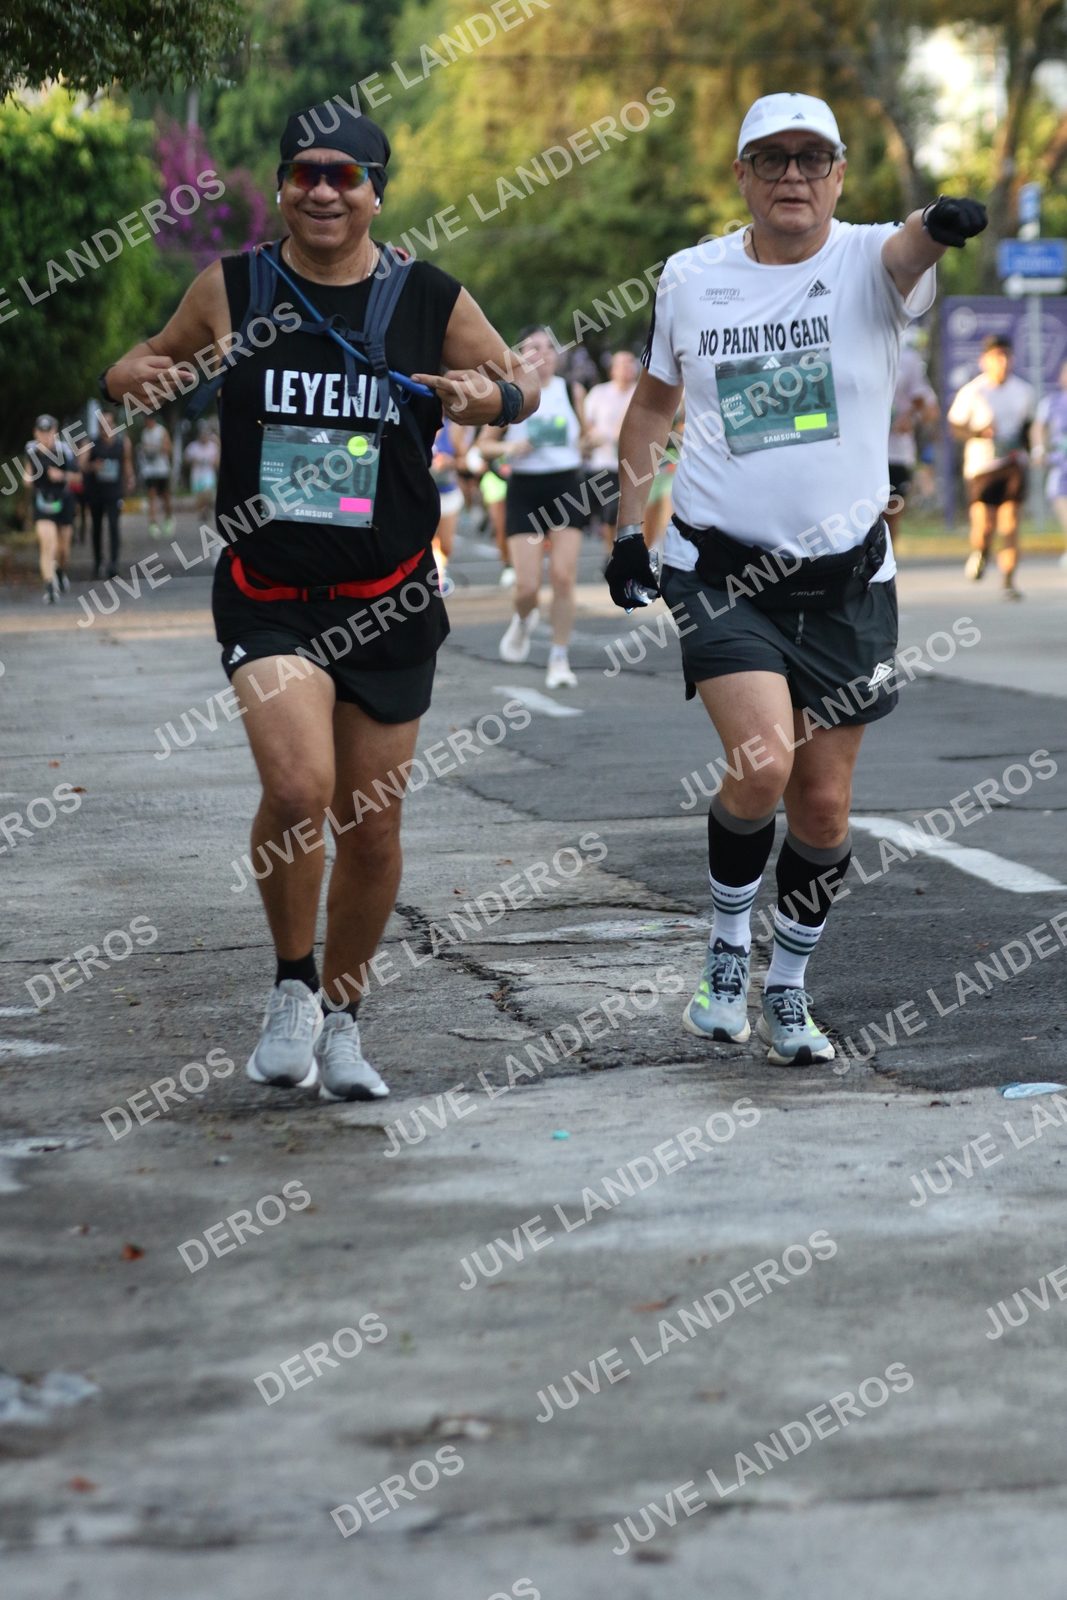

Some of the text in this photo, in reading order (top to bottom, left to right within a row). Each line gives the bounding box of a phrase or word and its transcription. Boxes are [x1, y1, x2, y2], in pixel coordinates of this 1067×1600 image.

[698, 315, 830, 356] NO PAIN NO GAIN
[763, 432, 801, 443] SAMSUNG
[294, 508, 333, 518] SAMSUNG
